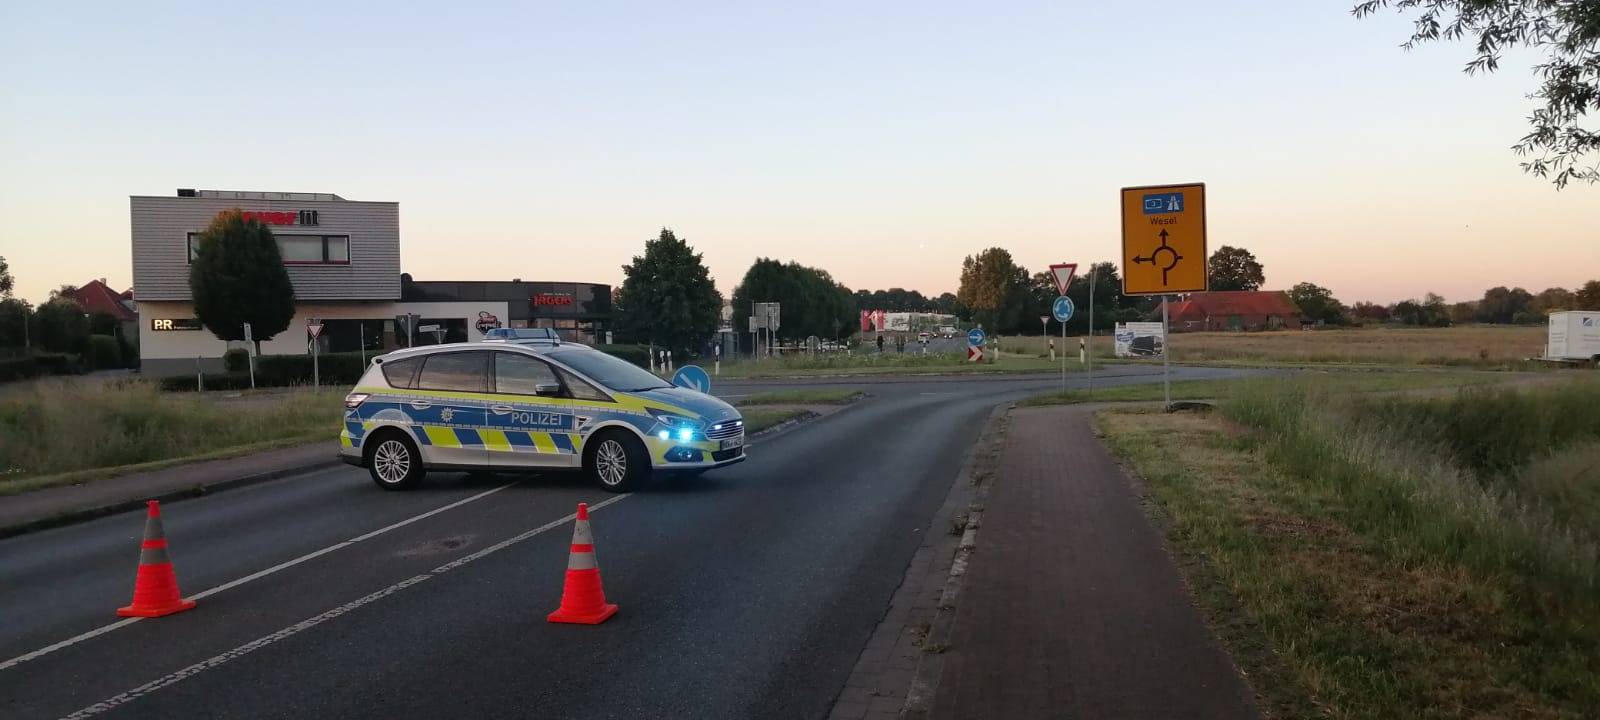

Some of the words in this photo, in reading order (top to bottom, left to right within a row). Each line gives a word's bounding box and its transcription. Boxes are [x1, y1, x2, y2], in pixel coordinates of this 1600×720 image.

[299, 209, 318, 226] fit
[1149, 216, 1177, 225] Wesel
[511, 412, 562, 426] POLIZEI
